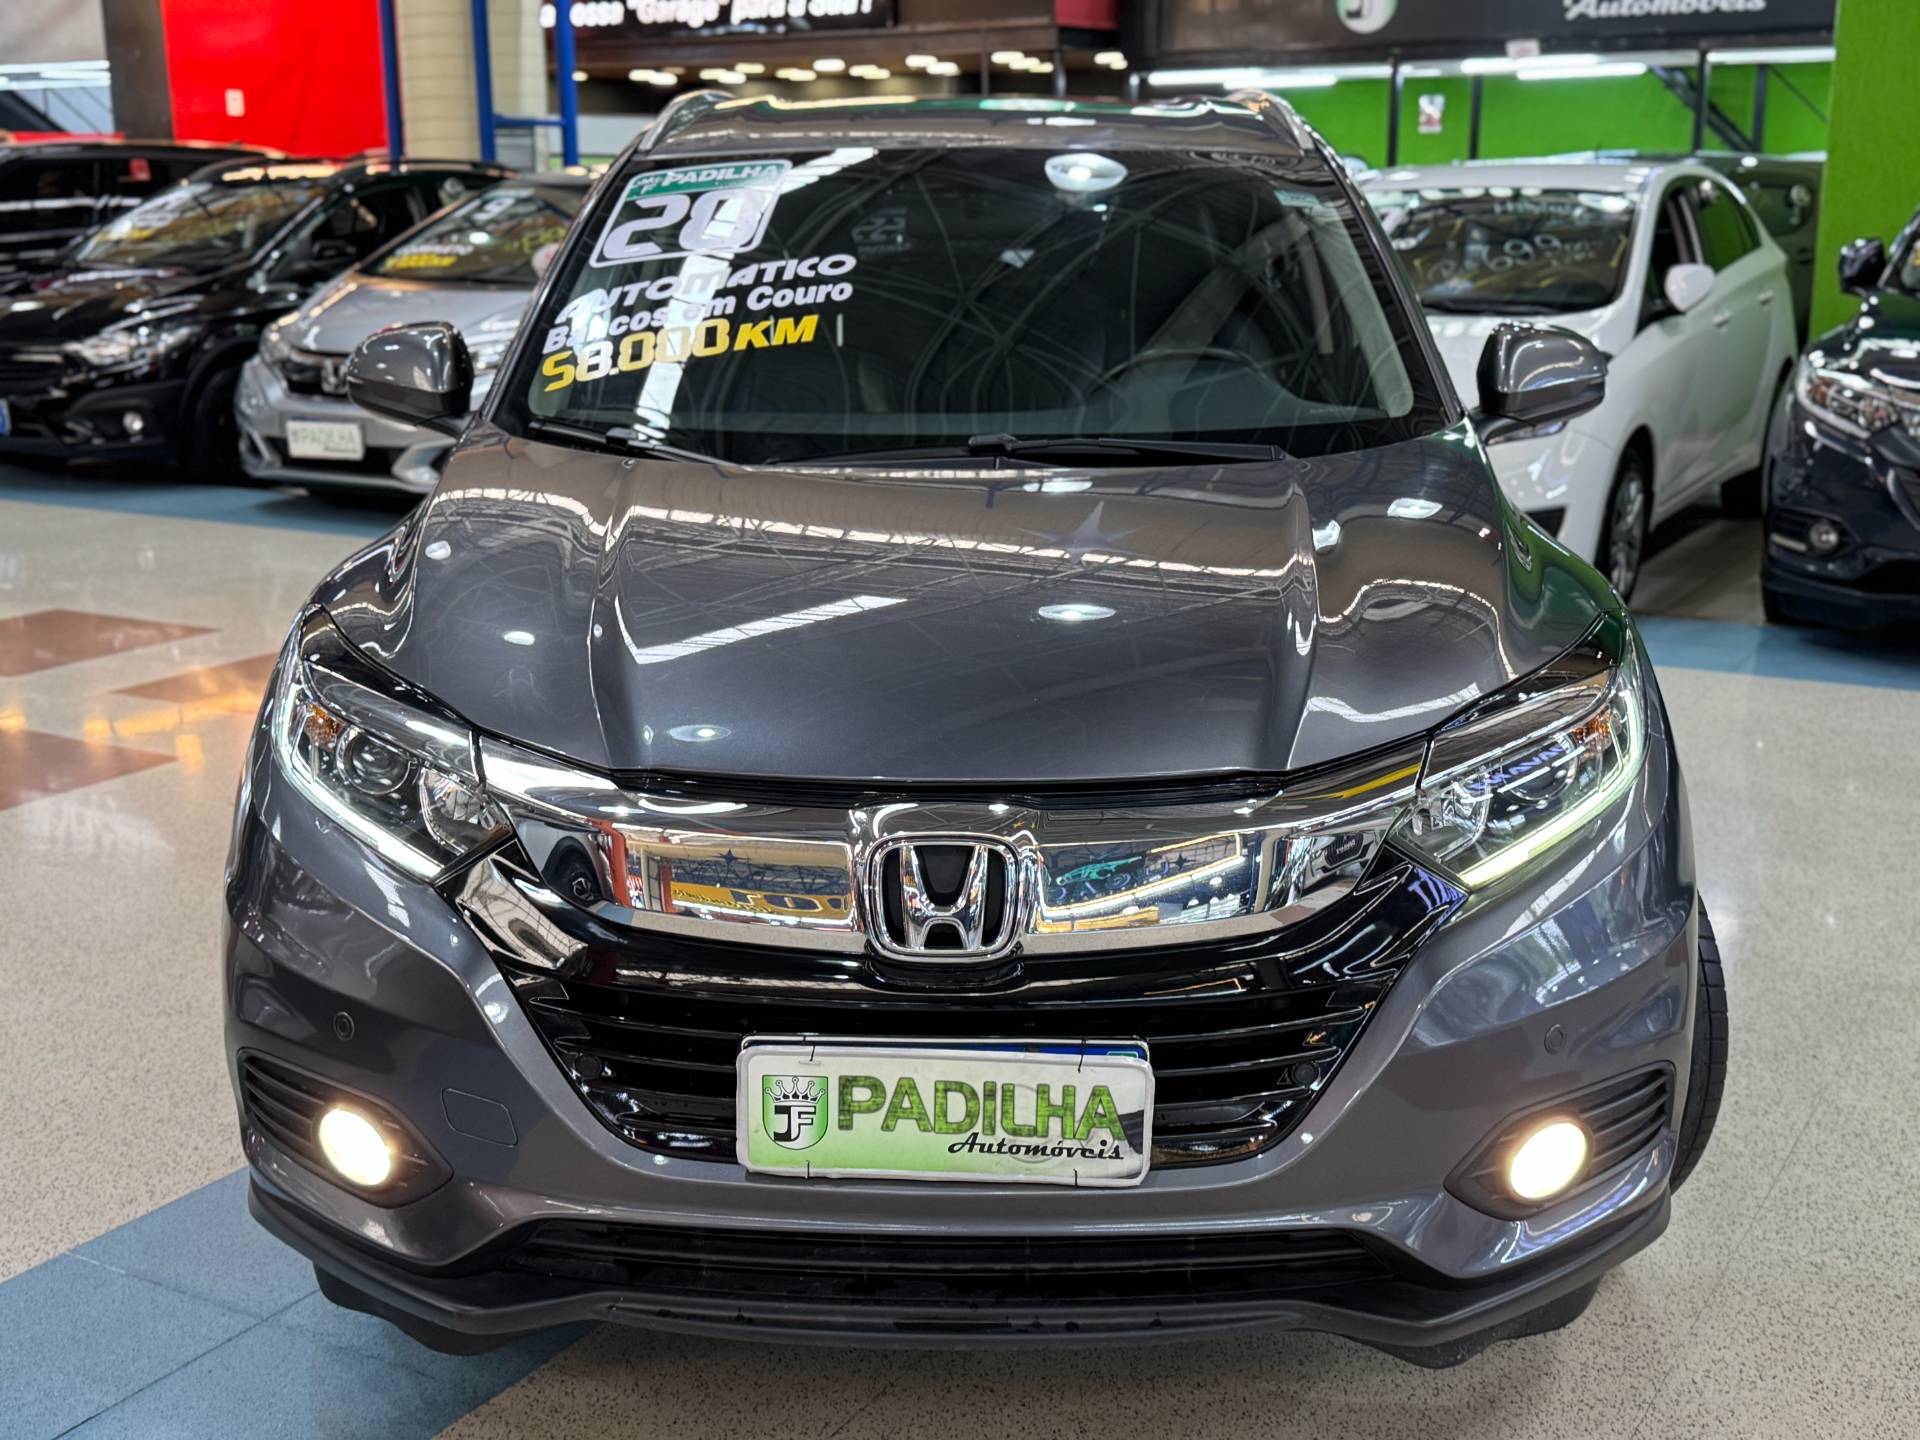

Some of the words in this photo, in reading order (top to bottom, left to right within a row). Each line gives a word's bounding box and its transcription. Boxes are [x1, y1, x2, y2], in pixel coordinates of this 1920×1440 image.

[661, 164, 779, 187] PADILHA
[603, 187, 766, 260] 20
[746, 281, 854, 309] Couro
[773, 1104, 816, 1142] JF
[837, 1073, 1130, 1143] PADILHA
[947, 1130, 1125, 1161] Automóveis
